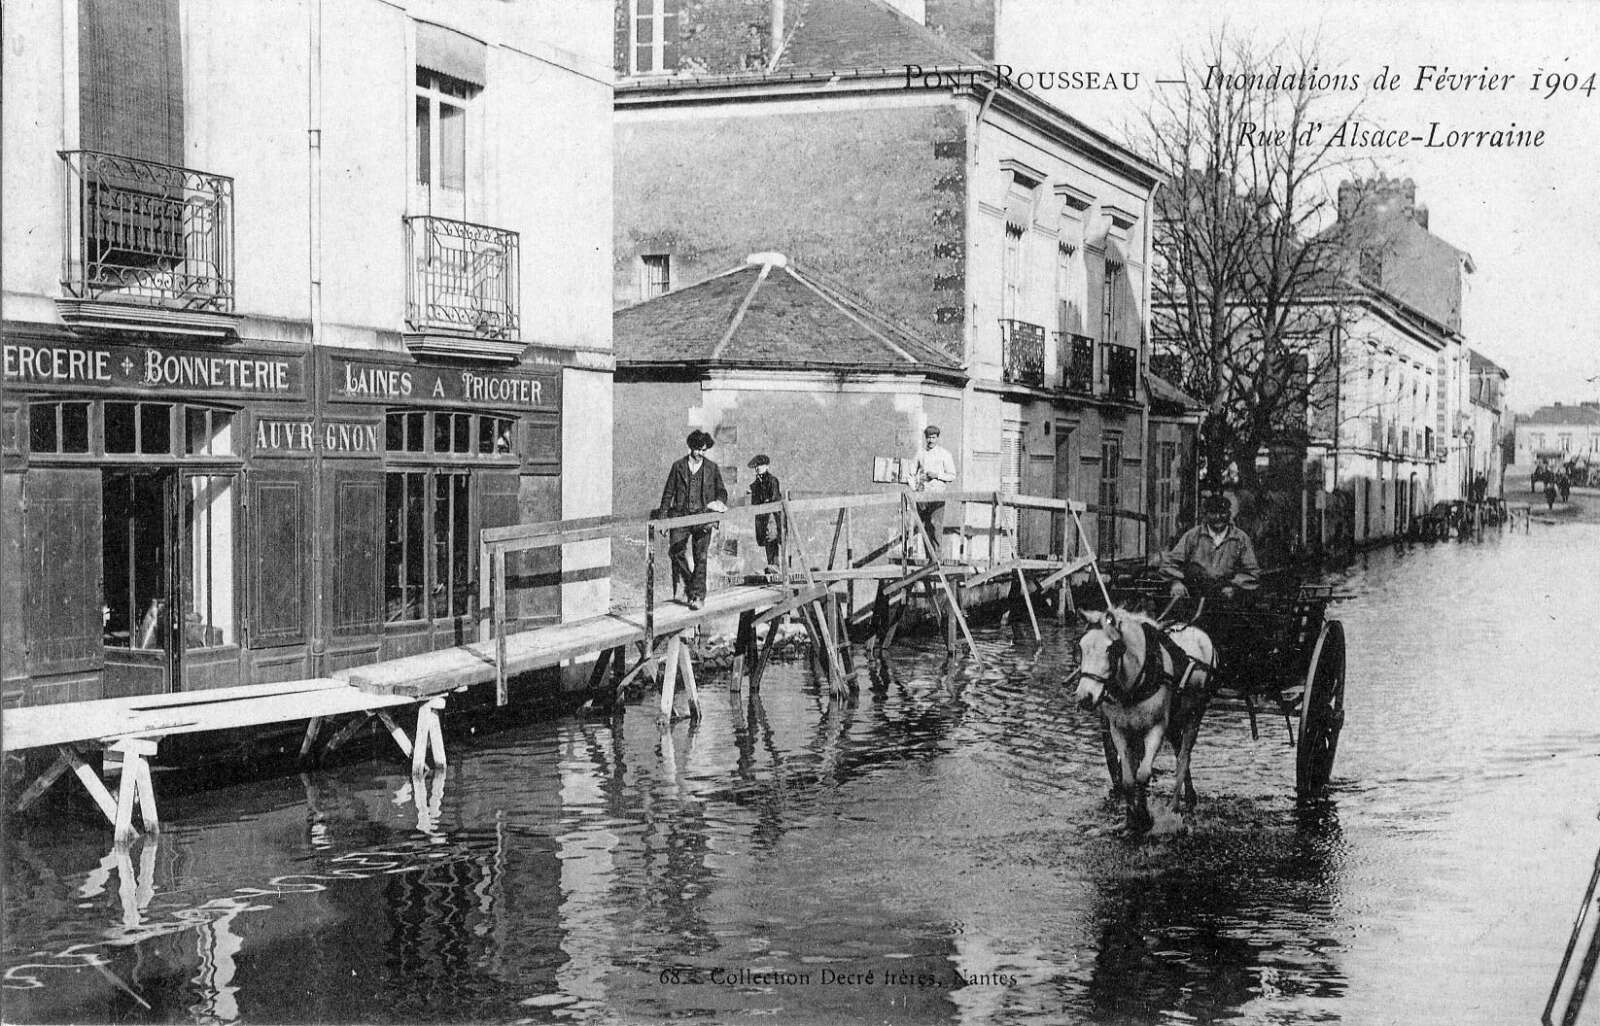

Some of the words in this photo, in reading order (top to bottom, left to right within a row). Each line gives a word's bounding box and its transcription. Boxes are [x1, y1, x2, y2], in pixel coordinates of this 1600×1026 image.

[145, 350, 289, 388] BONNETERIE
[344, 362, 412, 396] LAINES
[432, 376, 445, 397] A
[462, 373, 542, 401] TRICOTER
[256, 420, 377, 452] AUVRGNON
